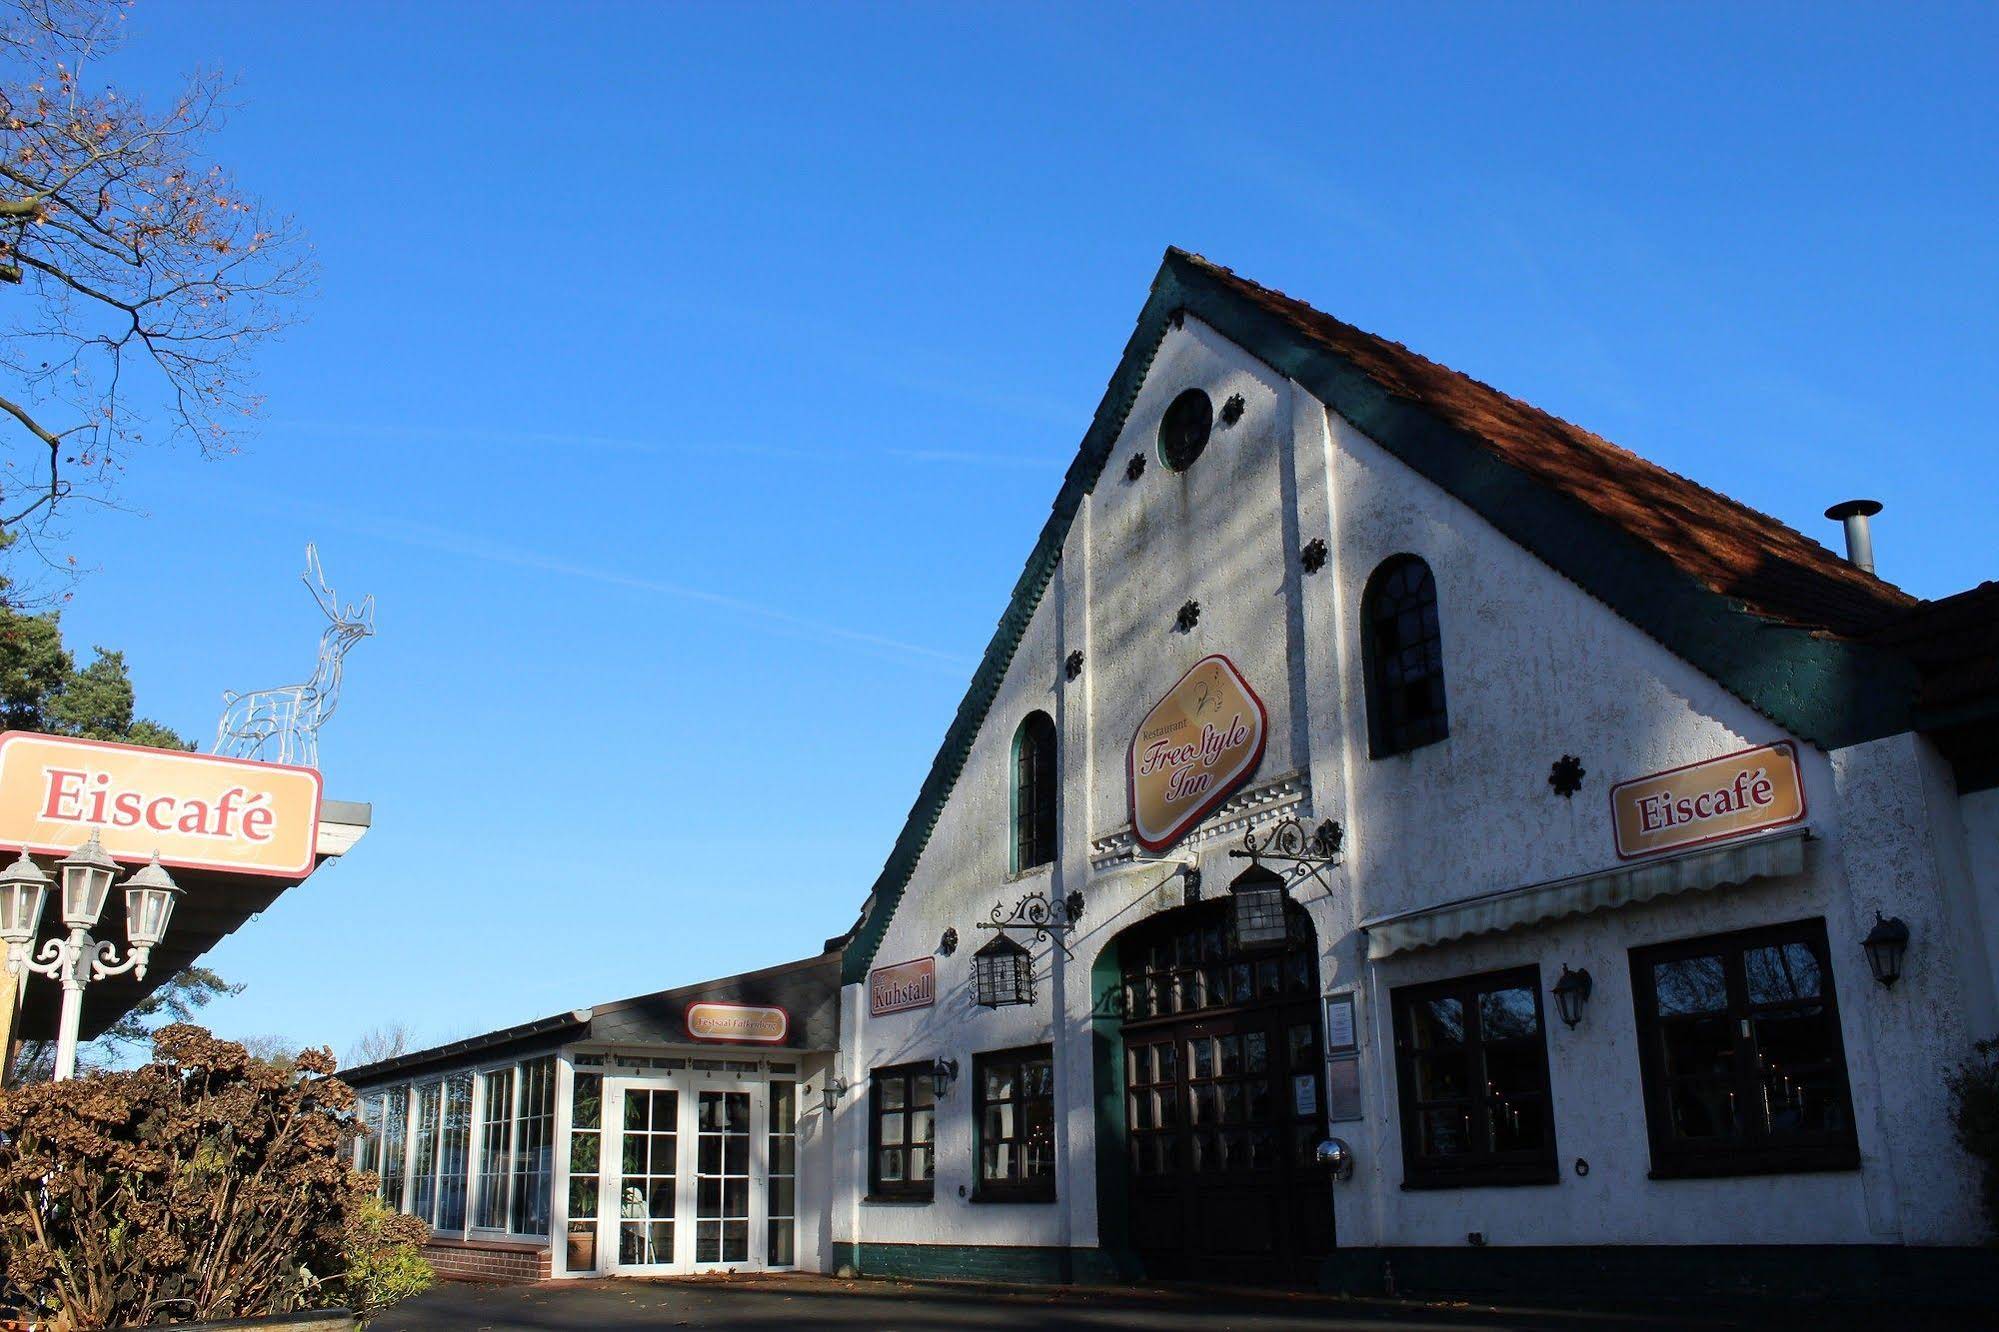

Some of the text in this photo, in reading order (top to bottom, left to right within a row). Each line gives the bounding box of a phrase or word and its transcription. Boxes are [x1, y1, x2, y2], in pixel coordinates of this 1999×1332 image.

[1142, 718, 1189, 741] Restaurant
[1165, 763, 1211, 802] Inn
[1637, 769, 1773, 832] Eiscafé
[41, 768, 273, 841] Eiscafé
[873, 974, 931, 1008] Kuhstall
